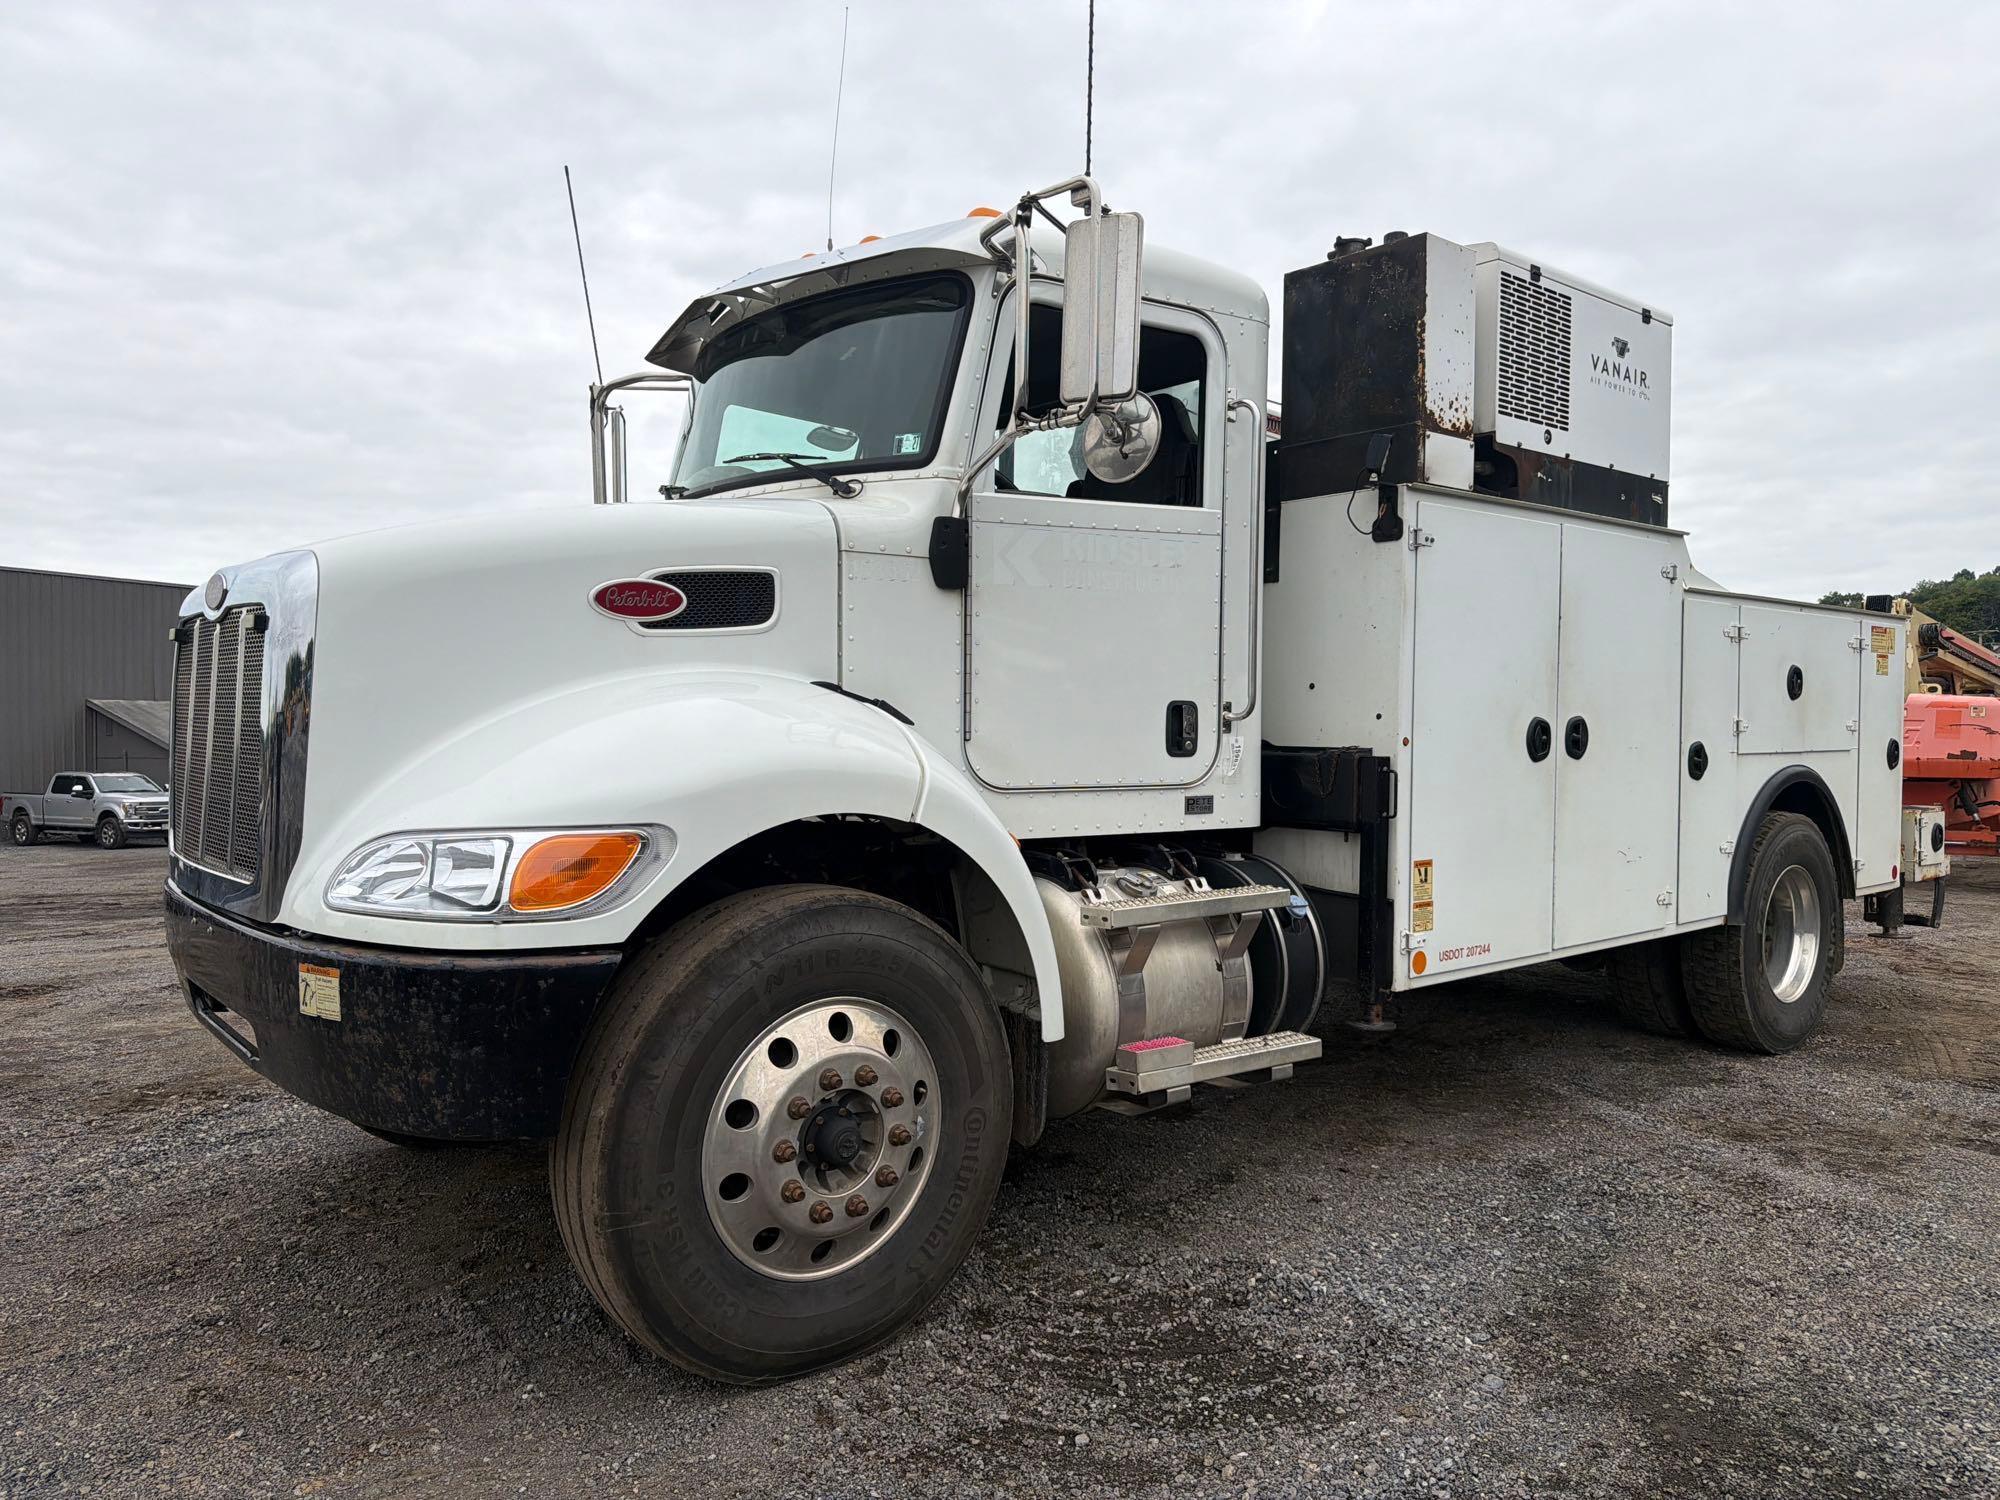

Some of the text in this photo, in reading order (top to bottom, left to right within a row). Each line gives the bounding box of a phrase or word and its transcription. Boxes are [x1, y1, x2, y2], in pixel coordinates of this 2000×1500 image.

[1591, 353, 1647, 389] VANAIR
[605, 586, 675, 608] Peterbilt
[1439, 943, 1491, 962] USDOT 207244
[920, 1107, 987, 1260] Continental
